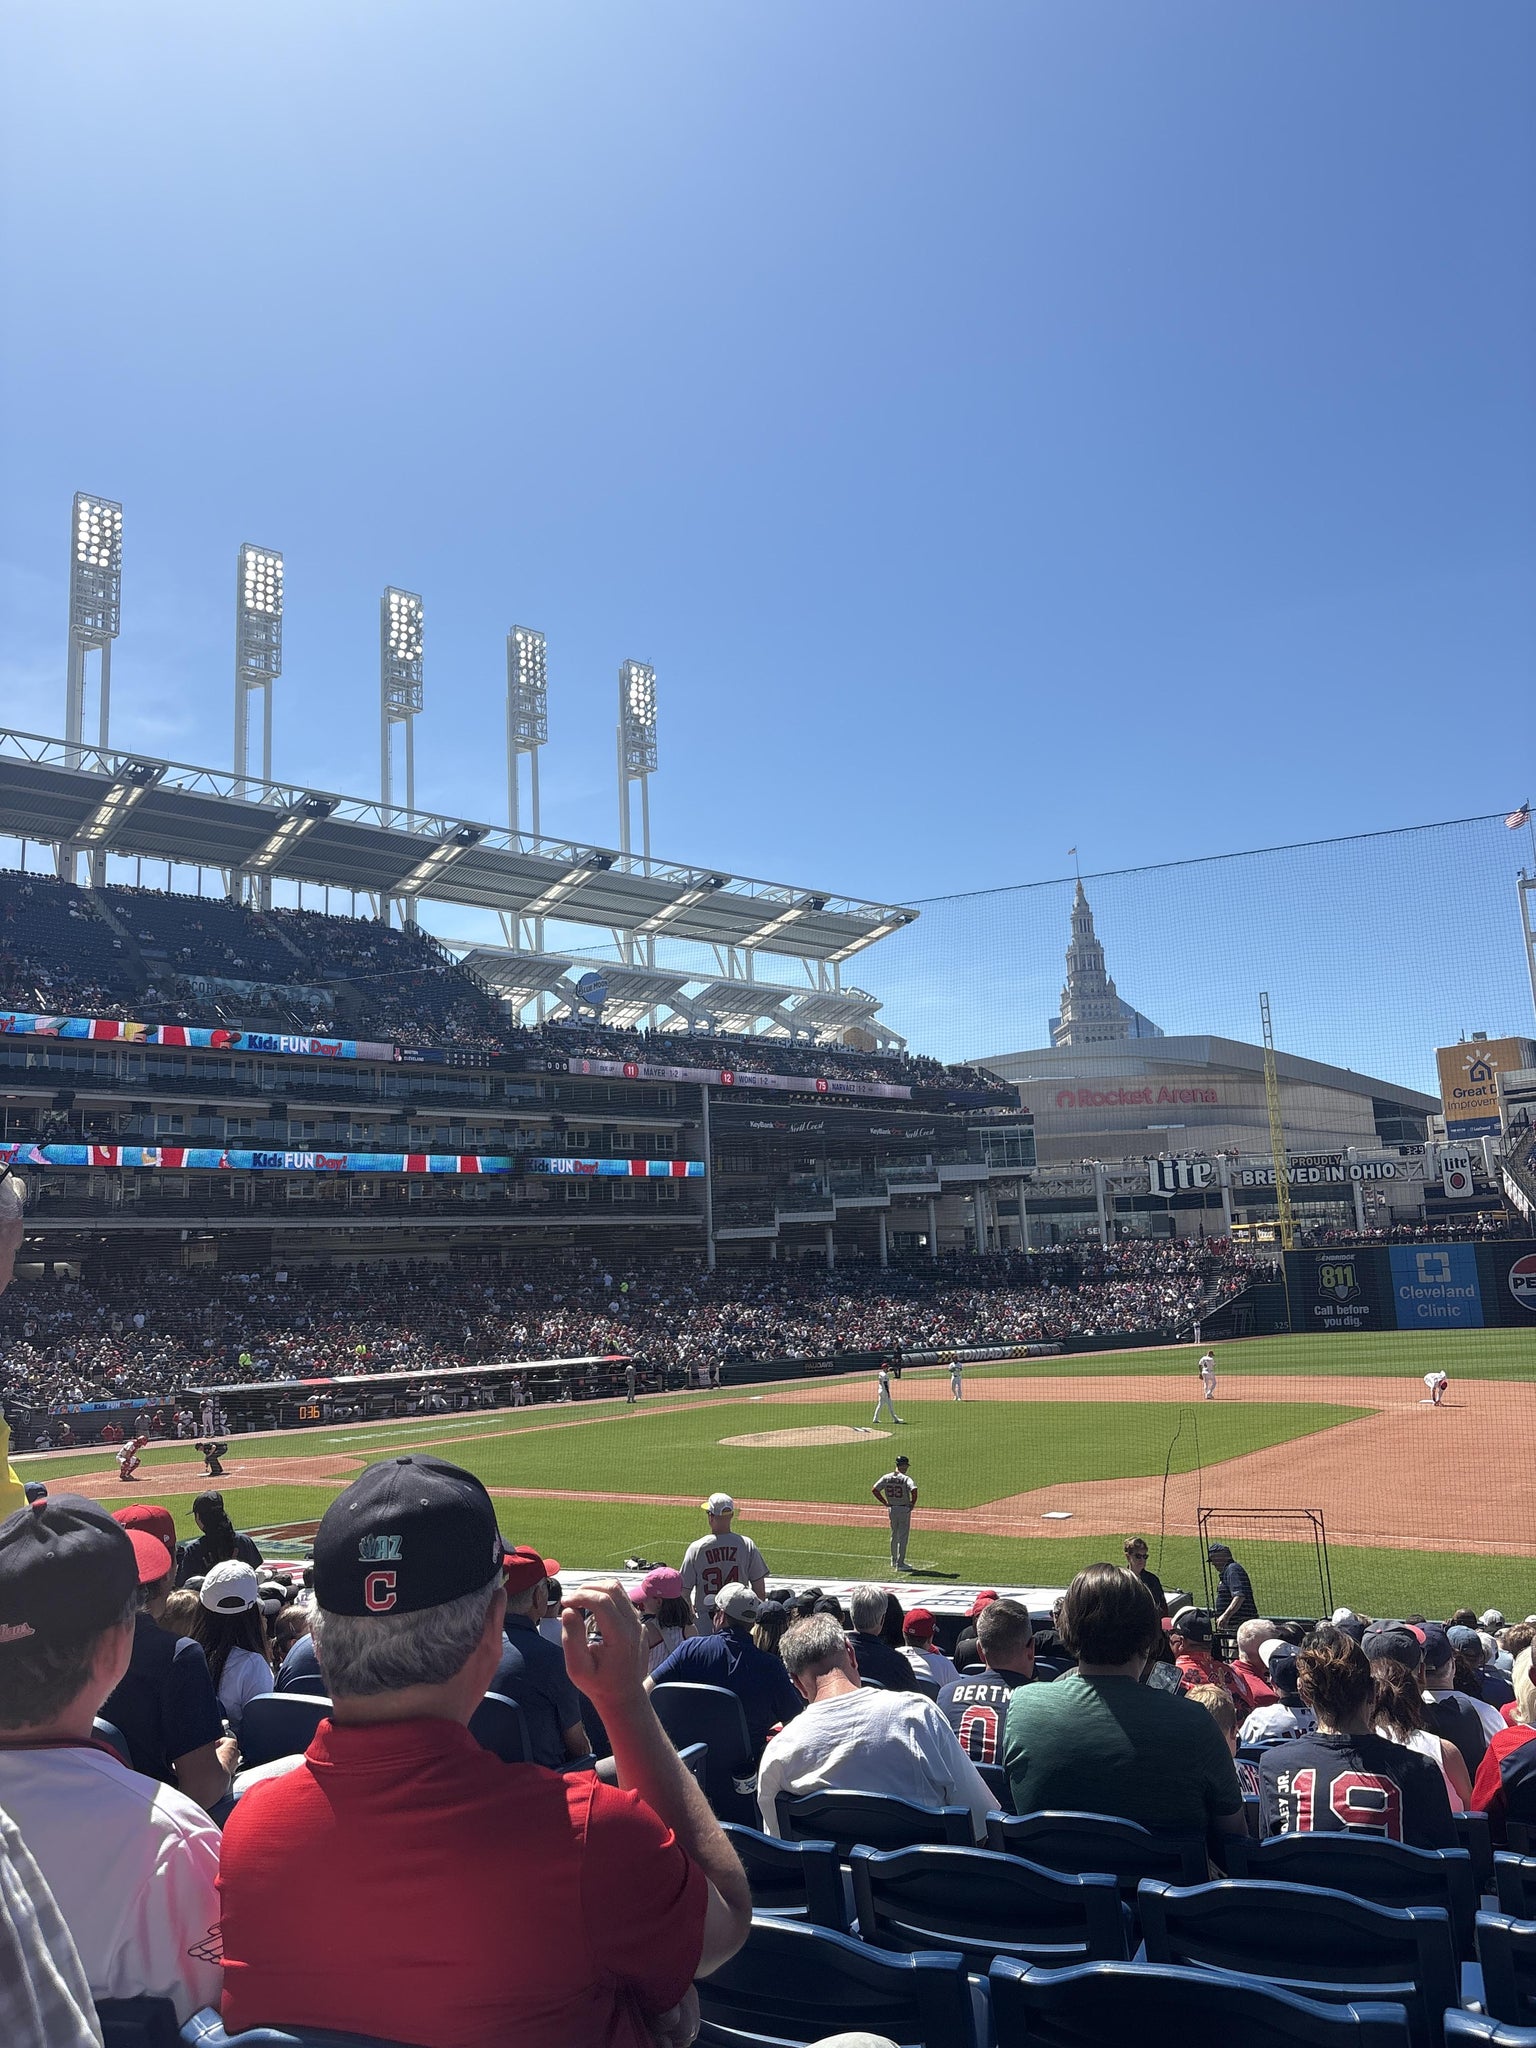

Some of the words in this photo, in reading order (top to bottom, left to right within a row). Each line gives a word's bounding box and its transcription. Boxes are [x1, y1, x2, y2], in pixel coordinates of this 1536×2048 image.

[249, 1034, 278, 1050] Kids
[280, 1036, 310, 1053] FUN
[311, 1040, 343, 1056] Day!
[627, 1065, 635, 1075] 11
[643, 1067, 666, 1077] MAYER
[723, 1073, 732, 1083] 12
[739, 1075, 757, 1085] WONG
[818, 1081, 827, 1090] 75
[1453, 1085, 1487, 1098] Great
[1077, 1087, 1153, 1107] Rocket
[1157, 1086, 1218, 1104] Arena
[252, 1152, 283, 1168] Kids
[284, 1152, 314, 1169] FUN
[315, 1154, 348, 1171] Day!
[550, 1158, 574, 1173] FUN
[574, 1160, 599, 1175] Day!
[1291, 1153, 1343, 1167] PROUDLY
[1443, 1157, 1468, 1173] Lite
[1144, 1159, 1213, 1199] Lite
[1324, 1166, 1345, 1183] IN
[1349, 1162, 1397, 1182] OHIO
[1321, 1265, 1354, 1288] 811
[1399, 1284, 1475, 1300] Cleveland
[1314, 1305, 1333, 1316] Call
[1336, 1304, 1370, 1315] before
[1417, 1303, 1461, 1318] Clinic
[1273, 1321, 1289, 1330] 325
[1323, 1318, 1342, 1329] you
[1343, 1316, 1363, 1327] dig.
[376, 1535, 403, 1560] AZ
[705, 1546, 738, 1565] ORTIZ
[702, 1565, 740, 1596] 34
[365, 1570, 397, 1612] C
[959, 1704, 999, 1765] 0
[1277, 1770, 1290, 1795] JR.
[1291, 1768, 1404, 1844] 19
